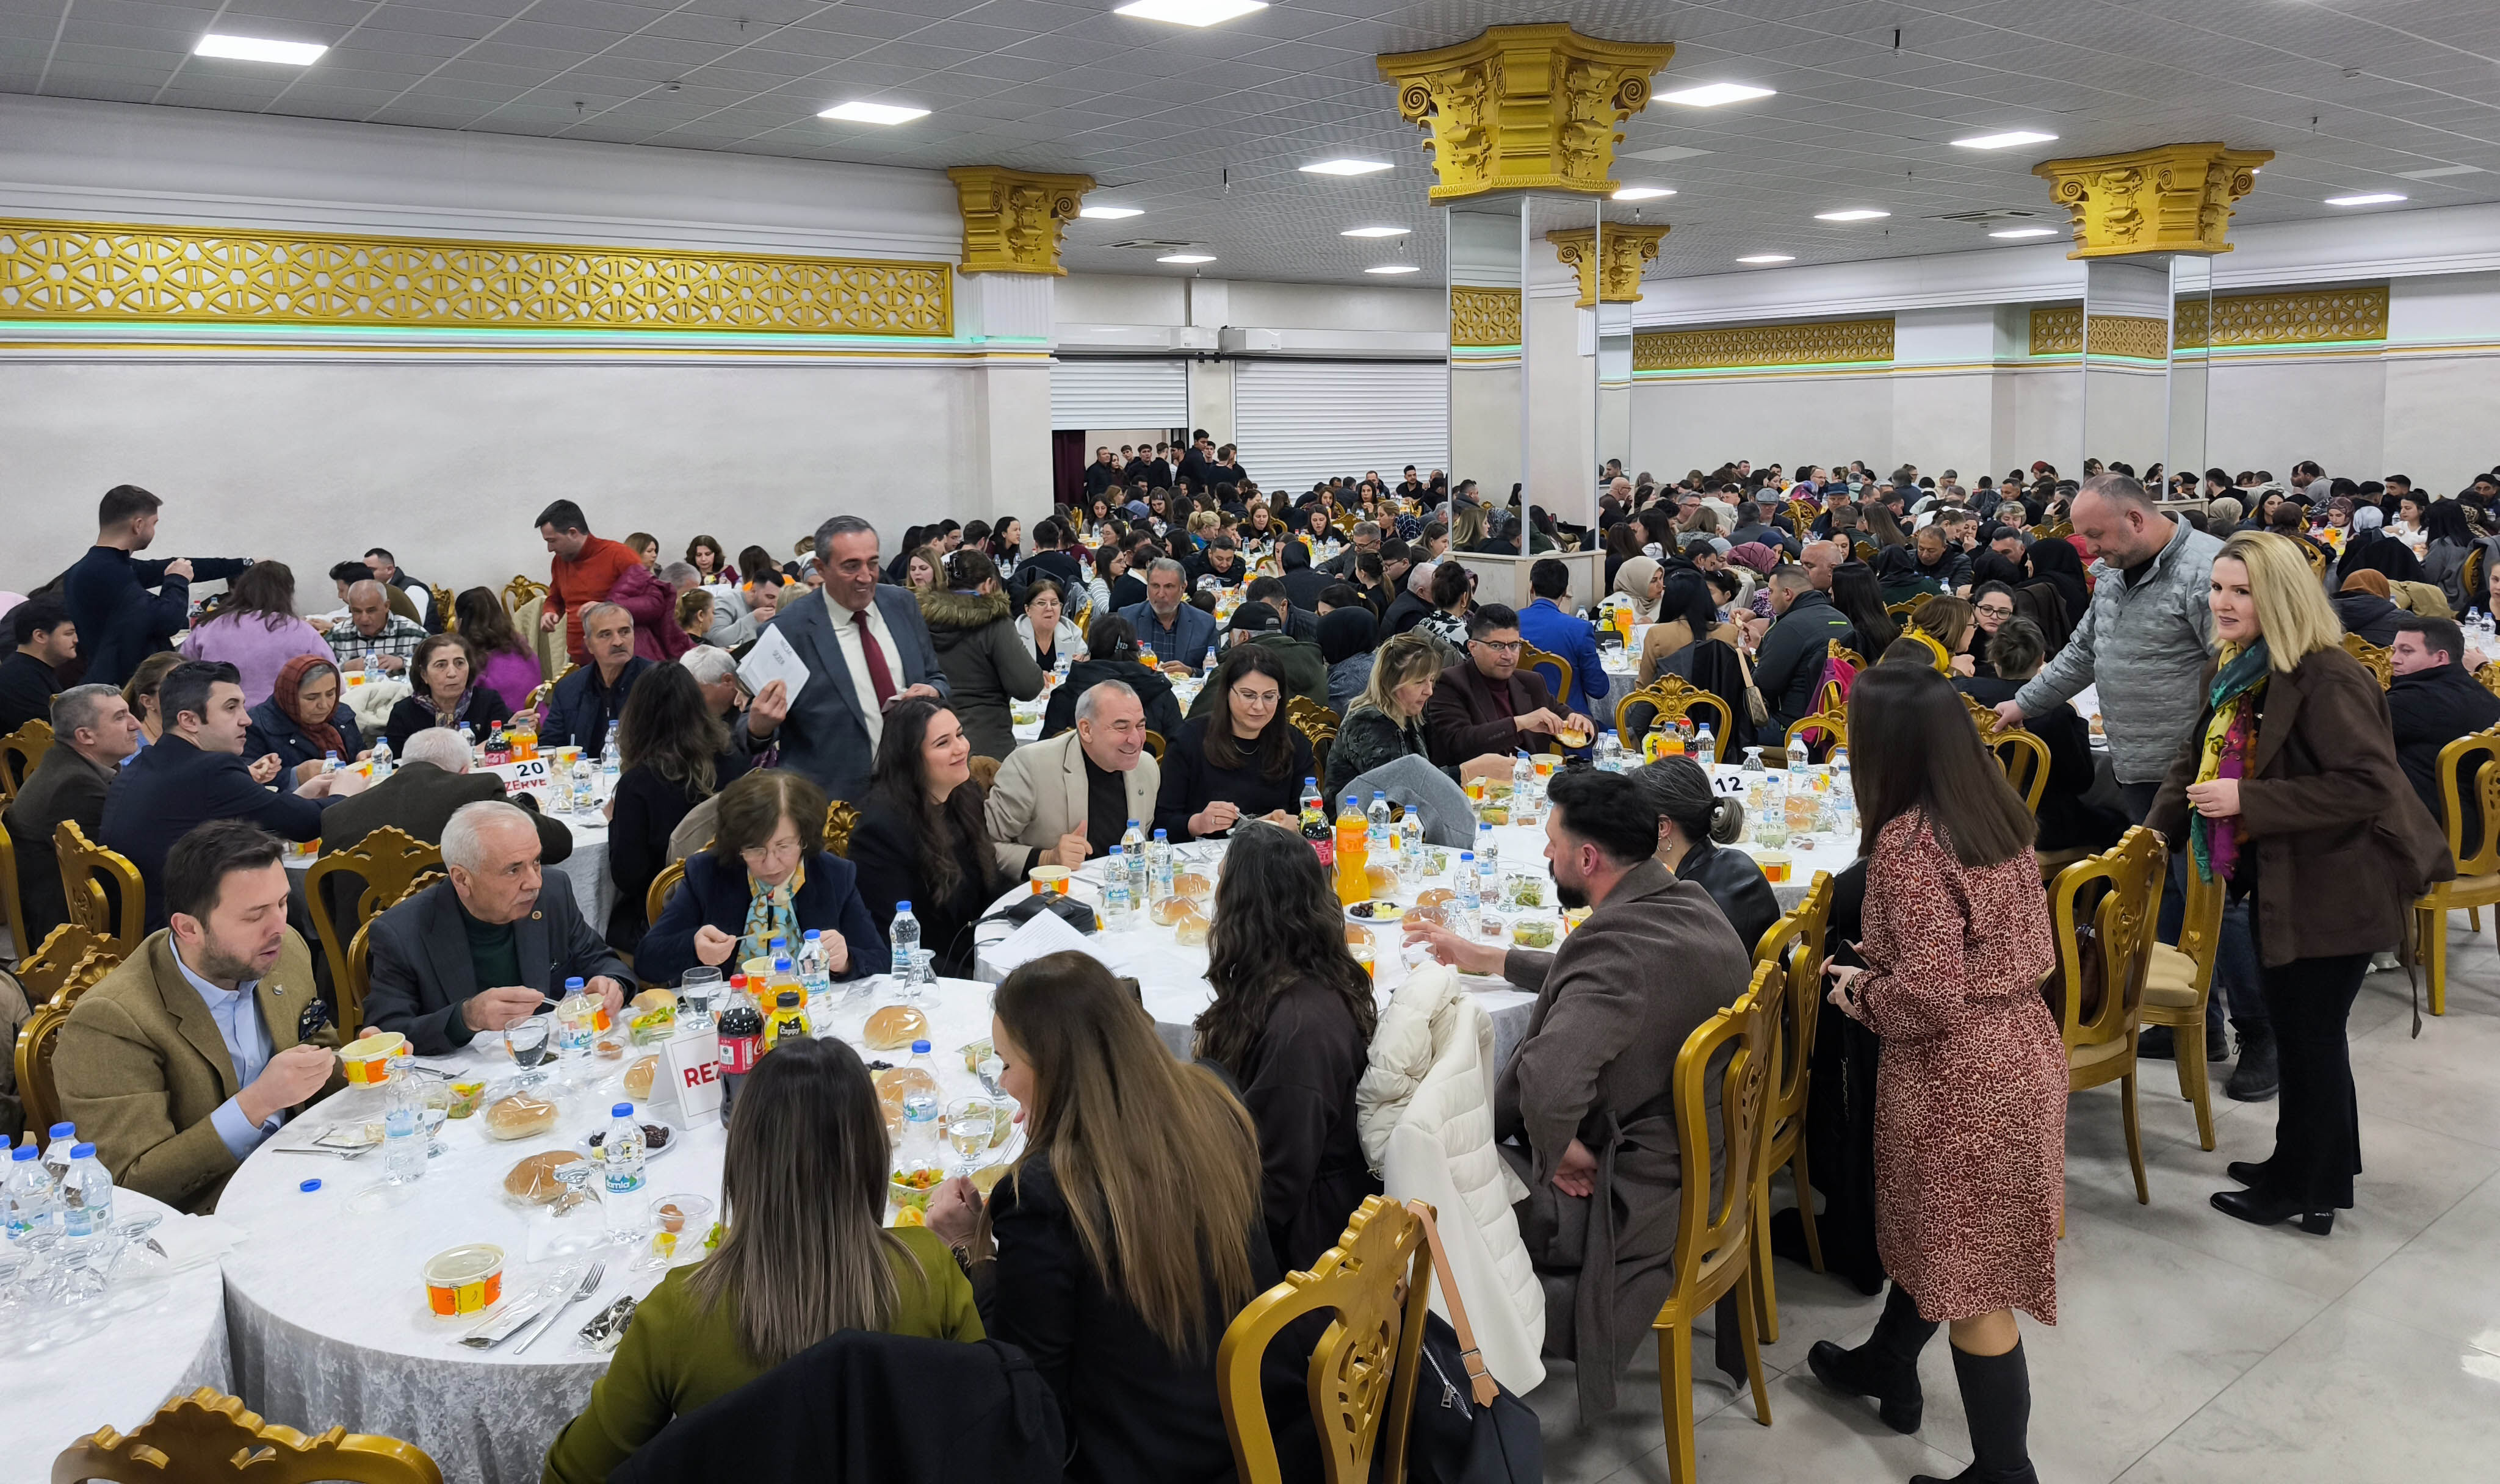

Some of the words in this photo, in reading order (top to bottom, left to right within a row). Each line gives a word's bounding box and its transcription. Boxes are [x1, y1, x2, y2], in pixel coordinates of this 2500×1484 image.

[516, 762, 544, 777] 20
[1715, 776, 1744, 792] 12
[779, 1026, 800, 1036] Cappy
